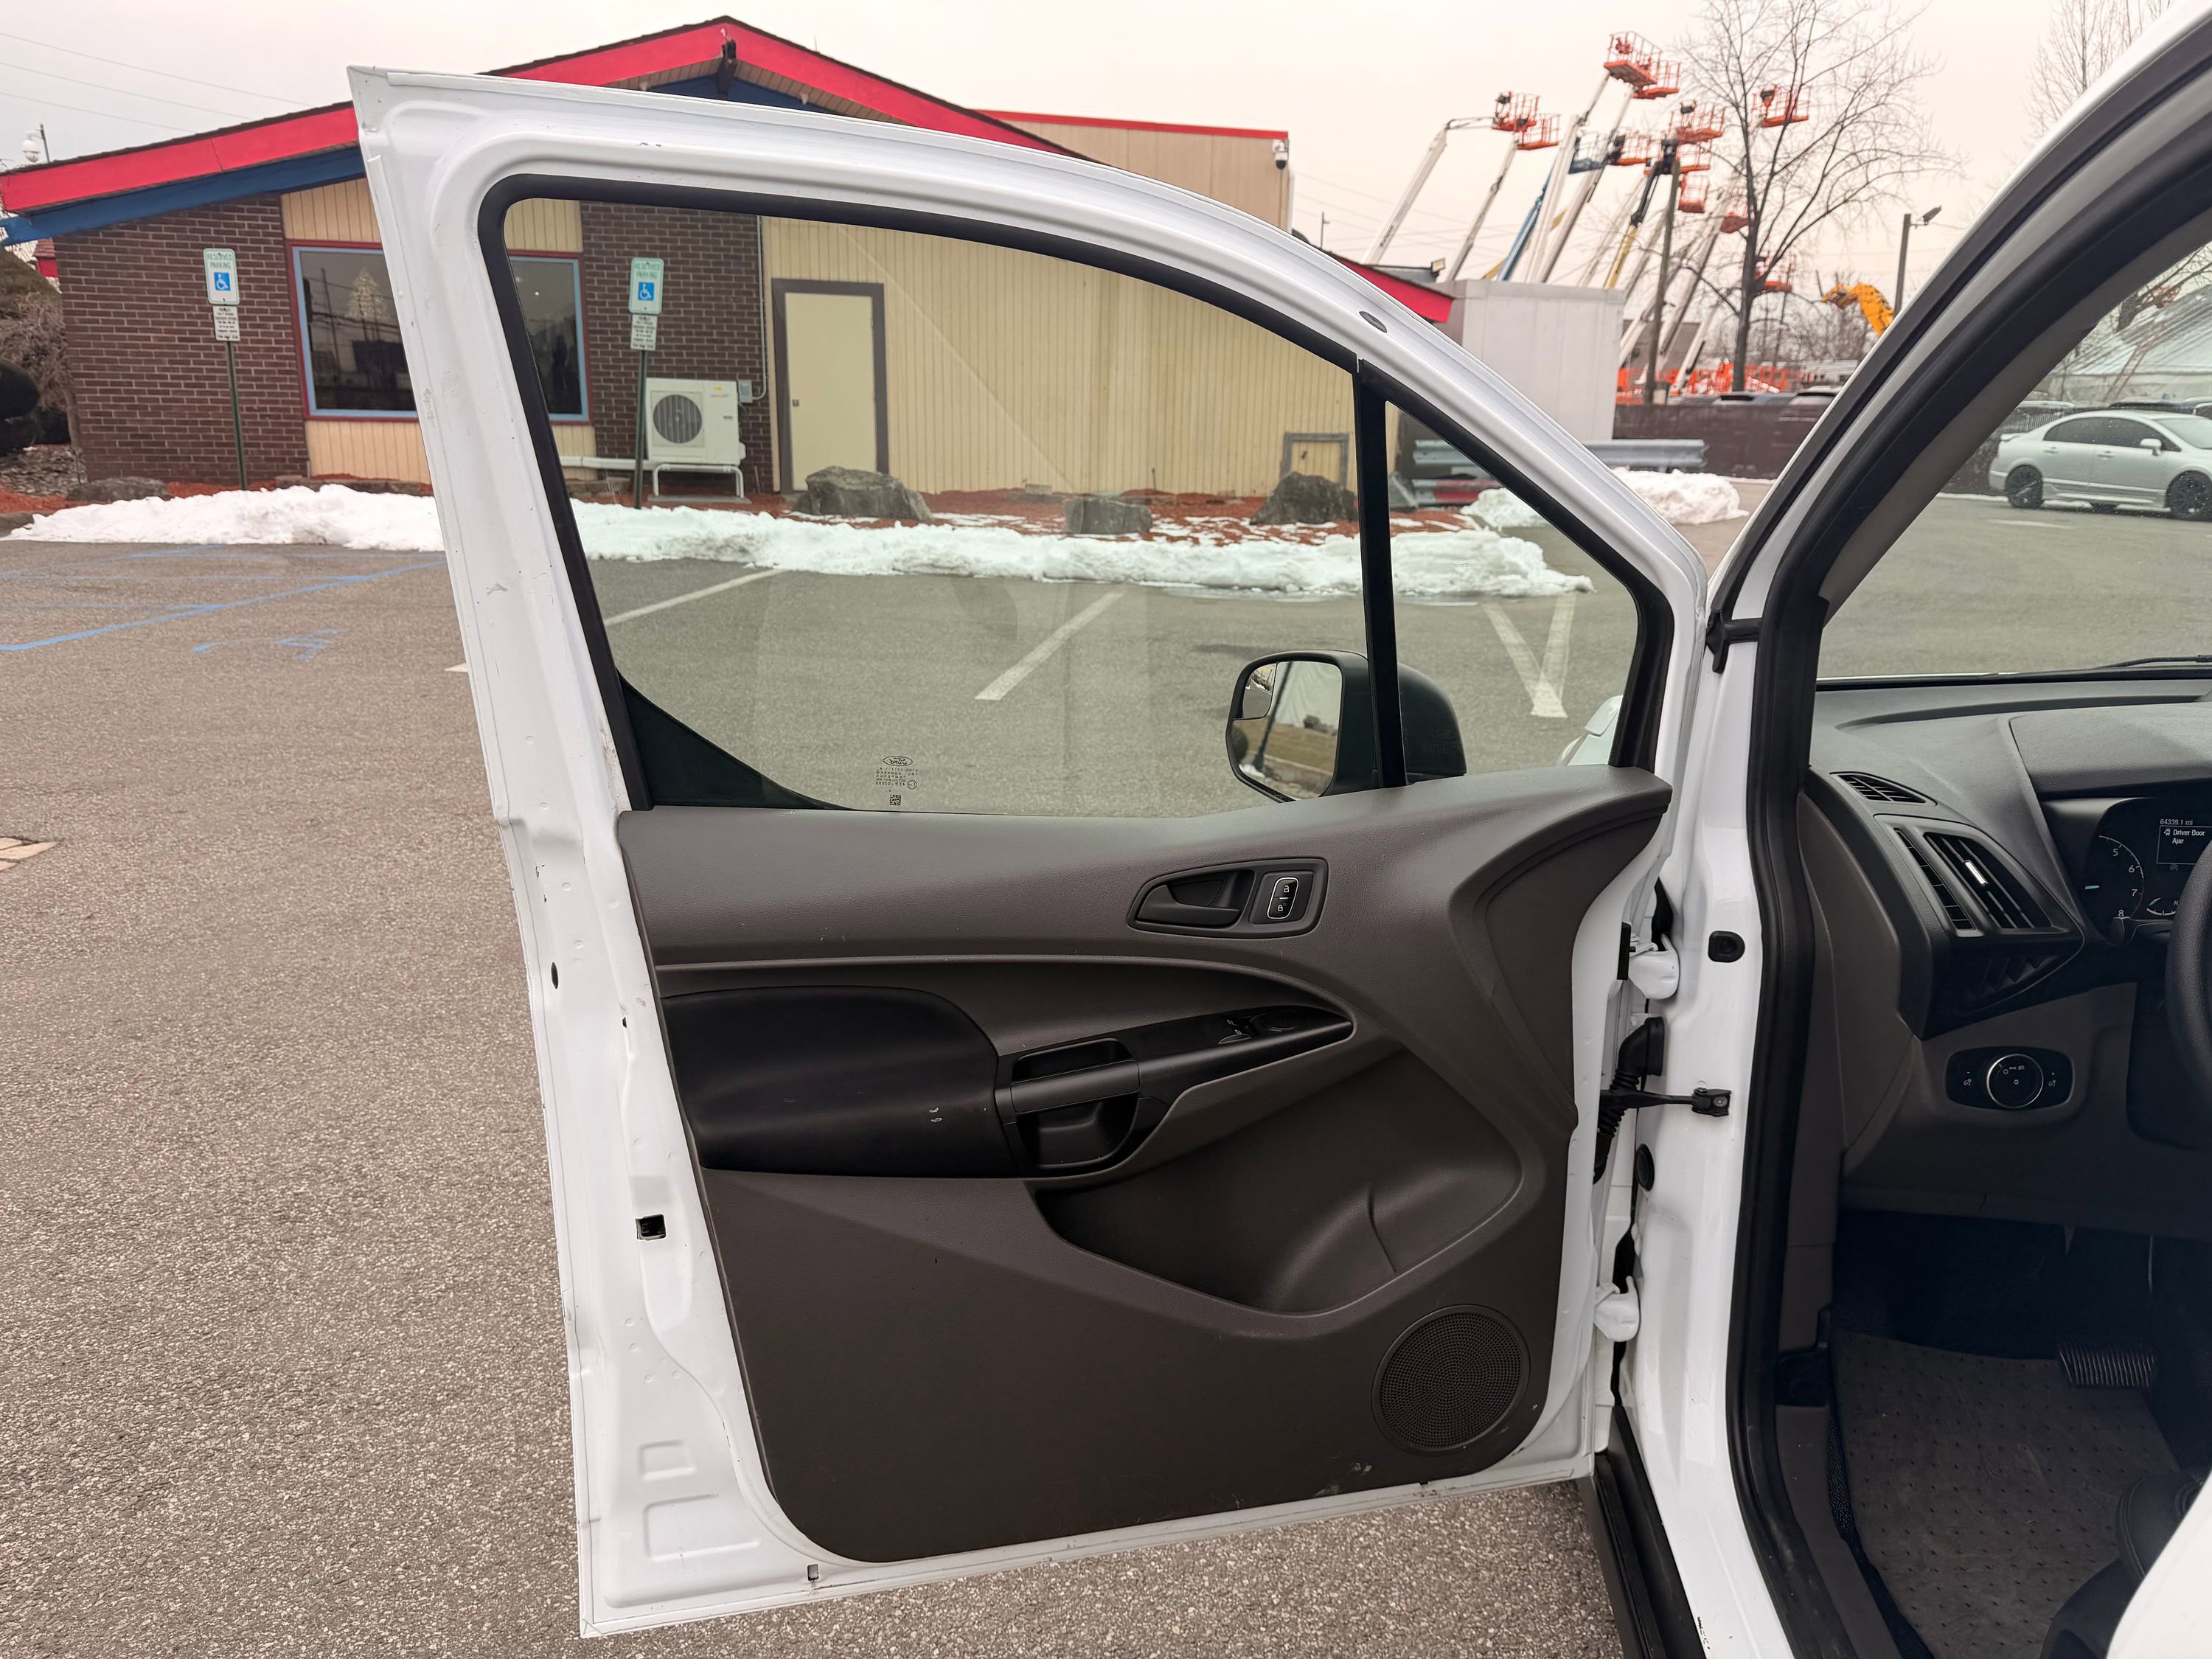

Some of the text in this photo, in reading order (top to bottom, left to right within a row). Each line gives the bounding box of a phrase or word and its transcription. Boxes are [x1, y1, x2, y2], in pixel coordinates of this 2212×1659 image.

[2112, 848, 2119, 856] 5
[2128, 864, 2135, 873] 6
[2131, 888, 2138, 897] 7
[2118, 909, 2124, 917] 8
